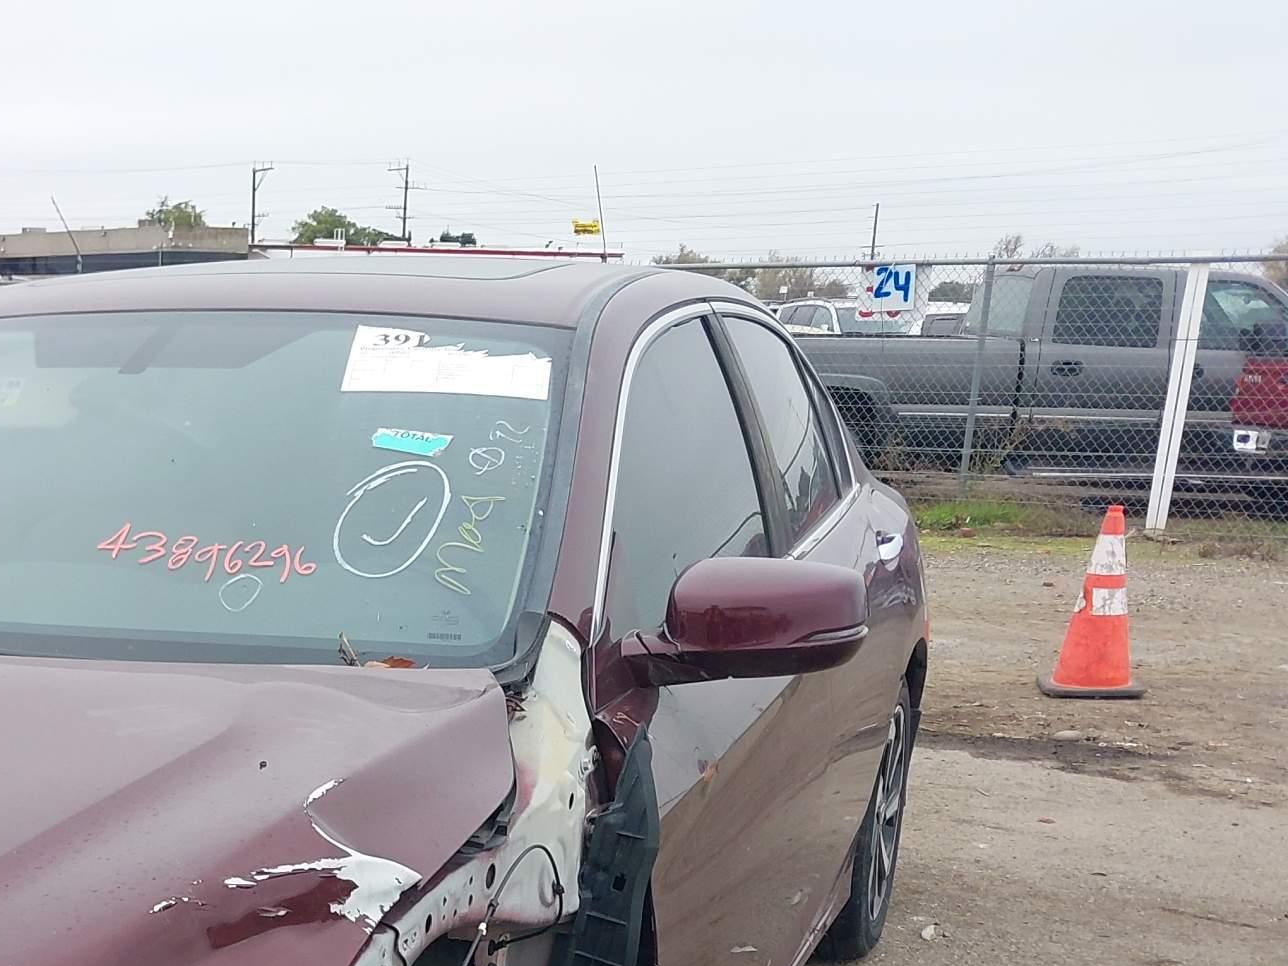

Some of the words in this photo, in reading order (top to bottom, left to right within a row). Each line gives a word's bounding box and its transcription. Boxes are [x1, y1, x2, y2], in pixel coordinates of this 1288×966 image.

[873, 265, 911, 302] 24
[392, 430, 432, 443] TOTAL
[97, 522, 317, 583] 43896296
